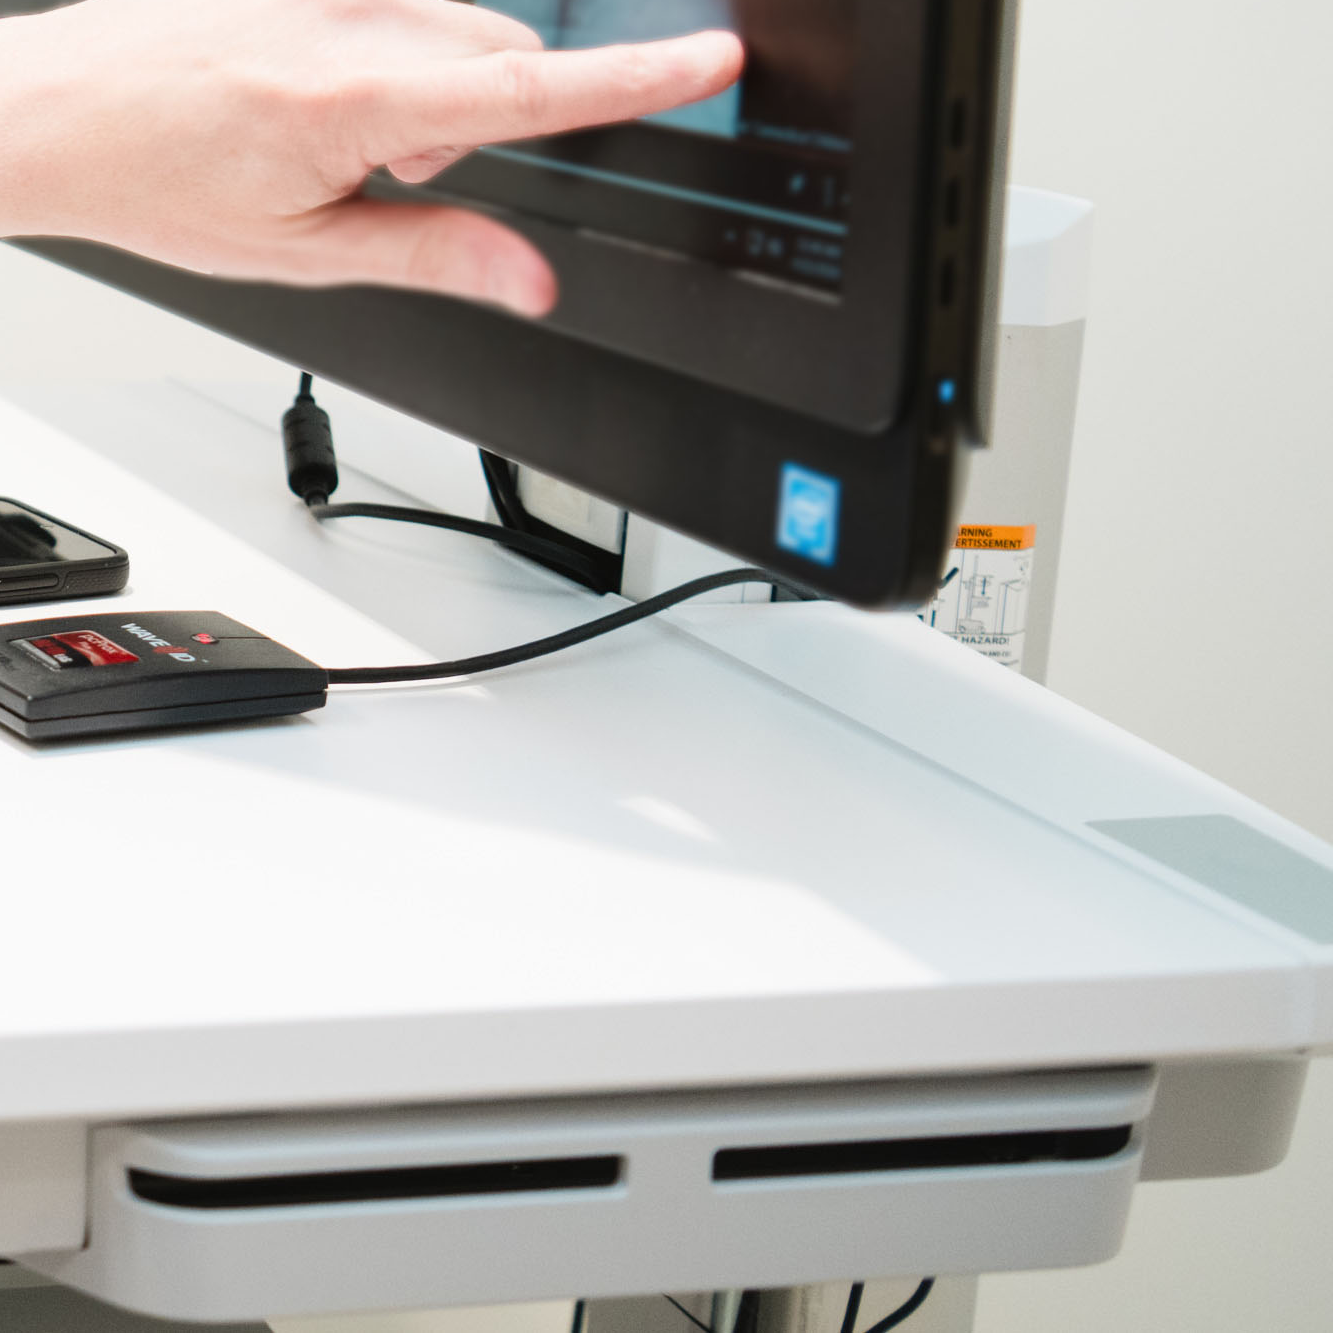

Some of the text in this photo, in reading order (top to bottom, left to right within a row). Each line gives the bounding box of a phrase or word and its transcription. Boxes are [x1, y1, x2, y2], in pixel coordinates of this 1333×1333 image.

[958, 528, 993, 538] RNING
[955, 538, 1022, 548] ERTISSEMENT
[121, 622, 172, 647] WAVE
